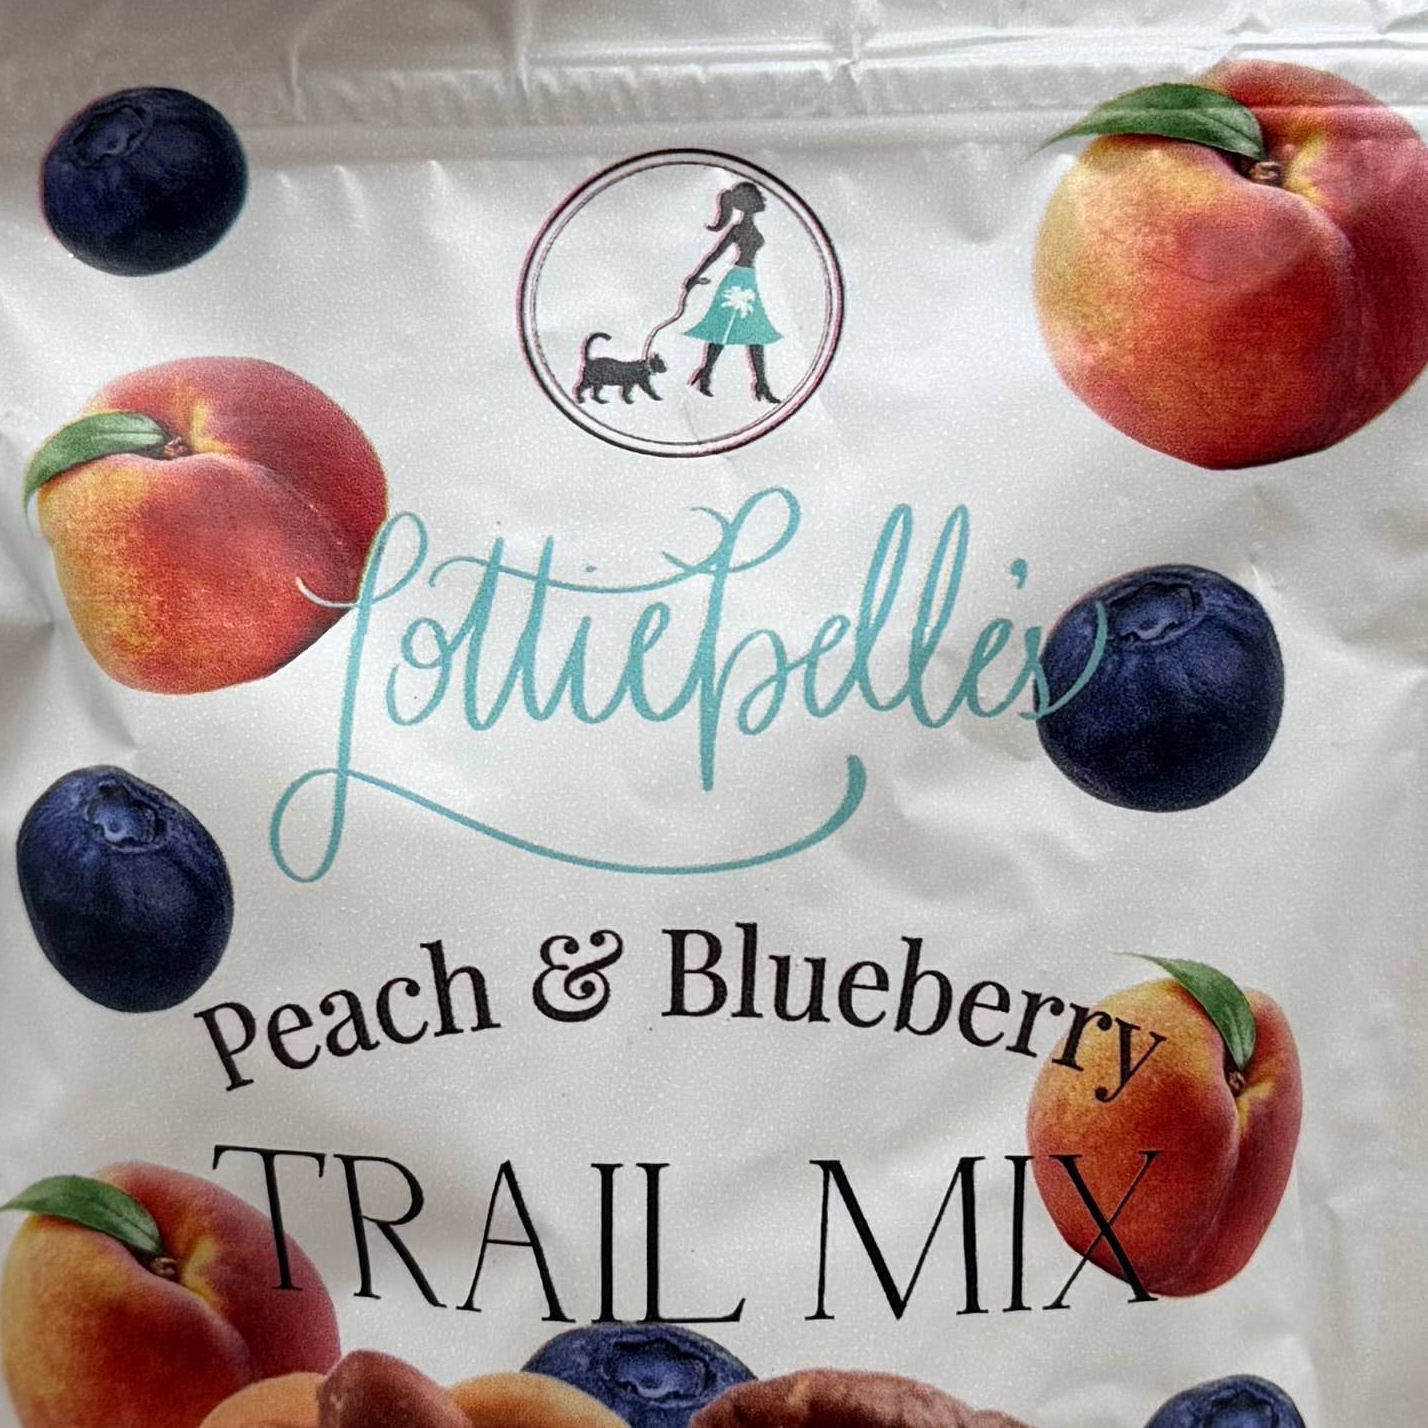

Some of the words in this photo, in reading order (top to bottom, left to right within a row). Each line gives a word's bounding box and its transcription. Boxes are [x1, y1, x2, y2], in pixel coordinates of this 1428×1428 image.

[193, 939, 502, 1092] Peach
[532, 929, 624, 1023] &
[660, 921, 1168, 1103] Blueberry
[212, 1144, 746, 1325] TRAIL
[802, 1149, 1160, 1322] MIX
